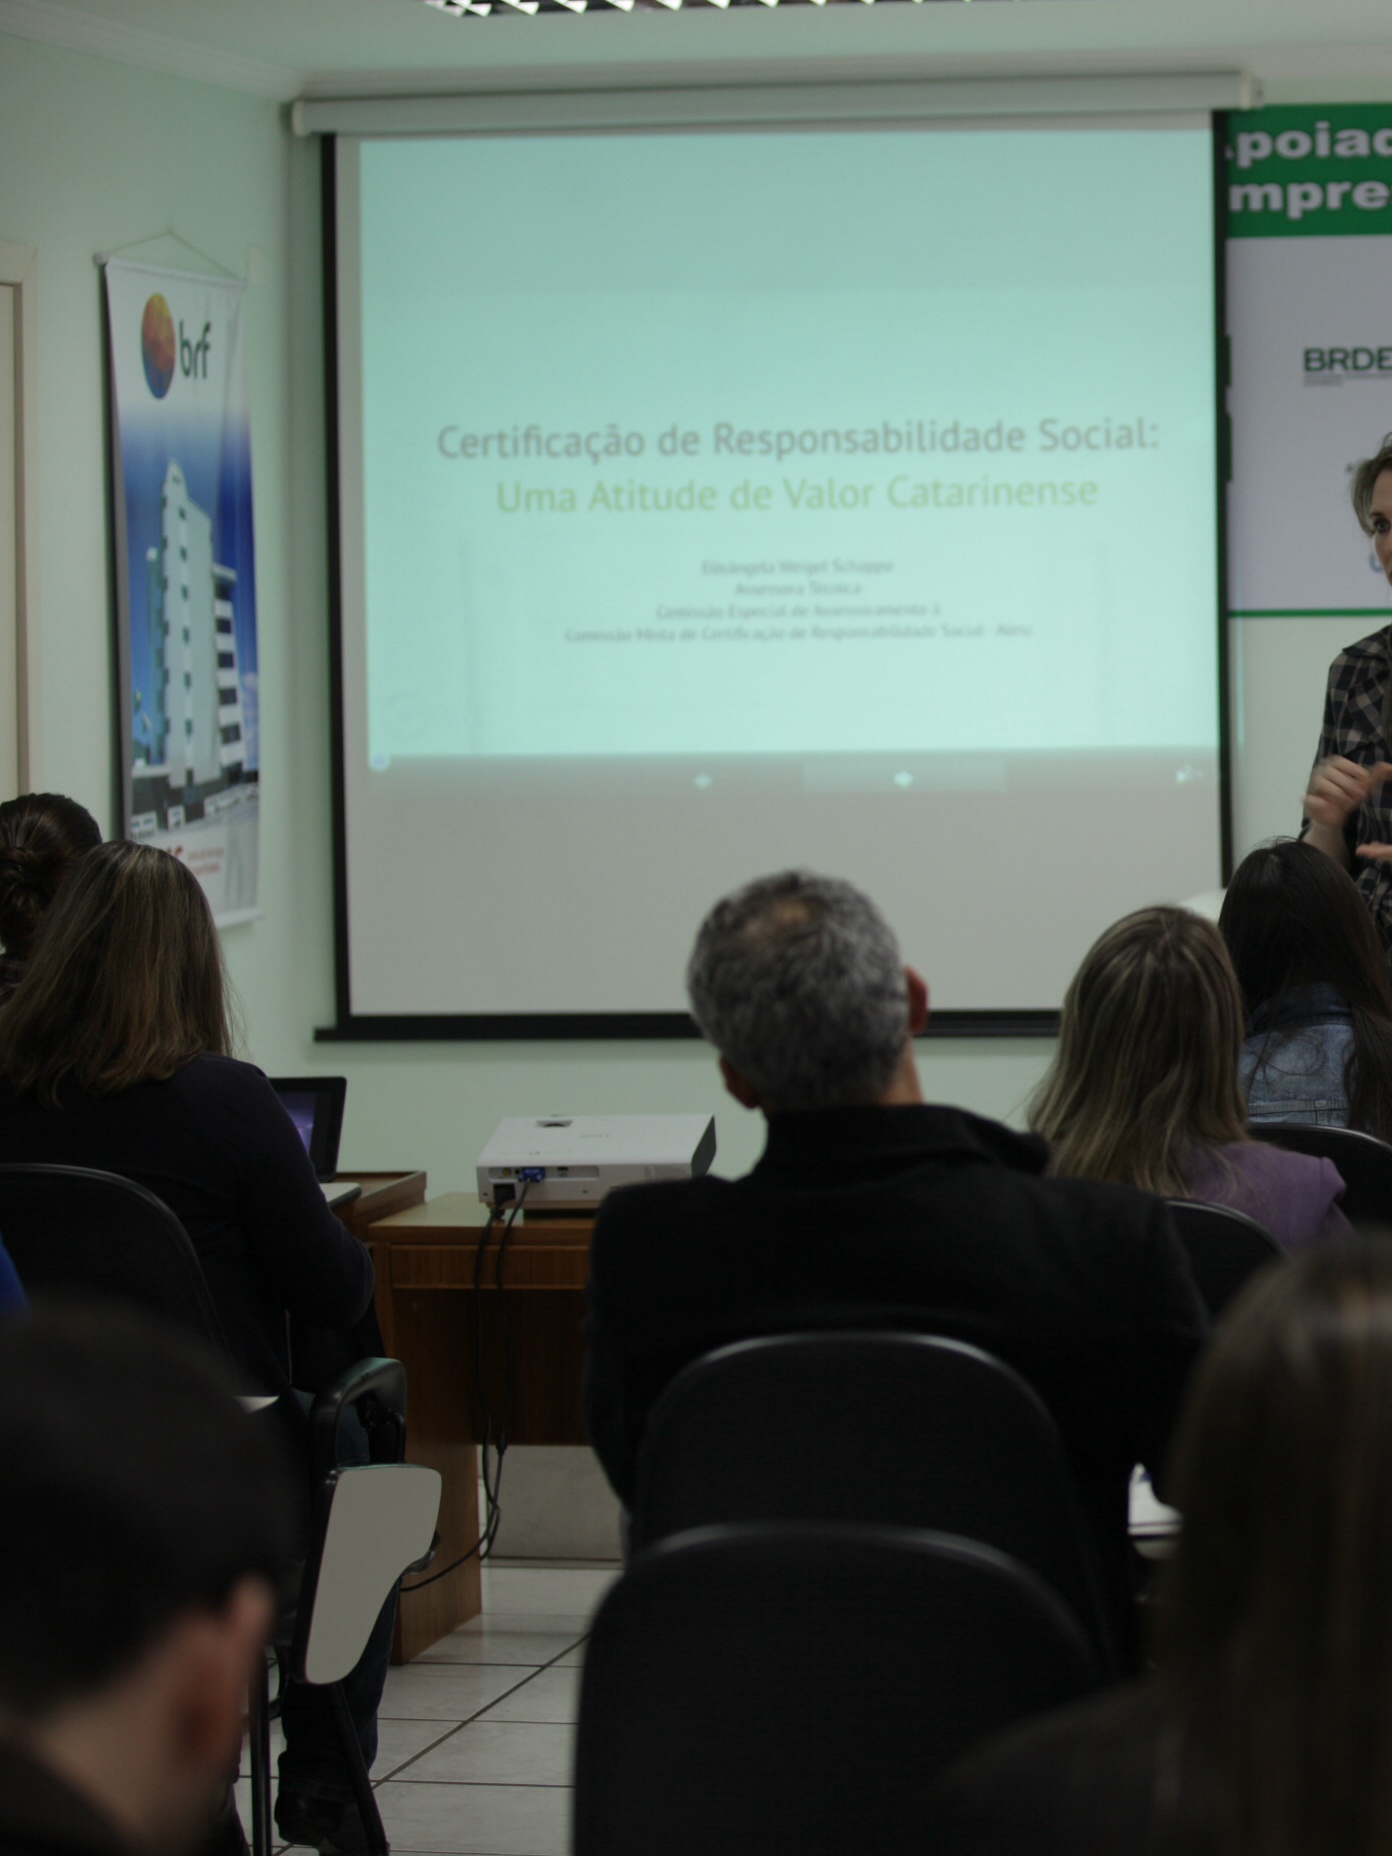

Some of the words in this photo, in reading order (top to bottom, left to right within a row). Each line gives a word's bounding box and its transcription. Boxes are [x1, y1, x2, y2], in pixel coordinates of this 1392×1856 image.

[179, 319, 211, 379] brf
[438, 424, 646, 465] Certificação
[658, 424, 700, 456] de
[713, 420, 1026, 462] Responsabilidade
[1038, 417, 1159, 451] Social:
[497, 481, 576, 514] Uma
[588, 478, 718, 512] Atitude
[730, 478, 774, 511] de
[783, 477, 875, 510] Valor
[886, 474, 1099, 508] Catarinense
